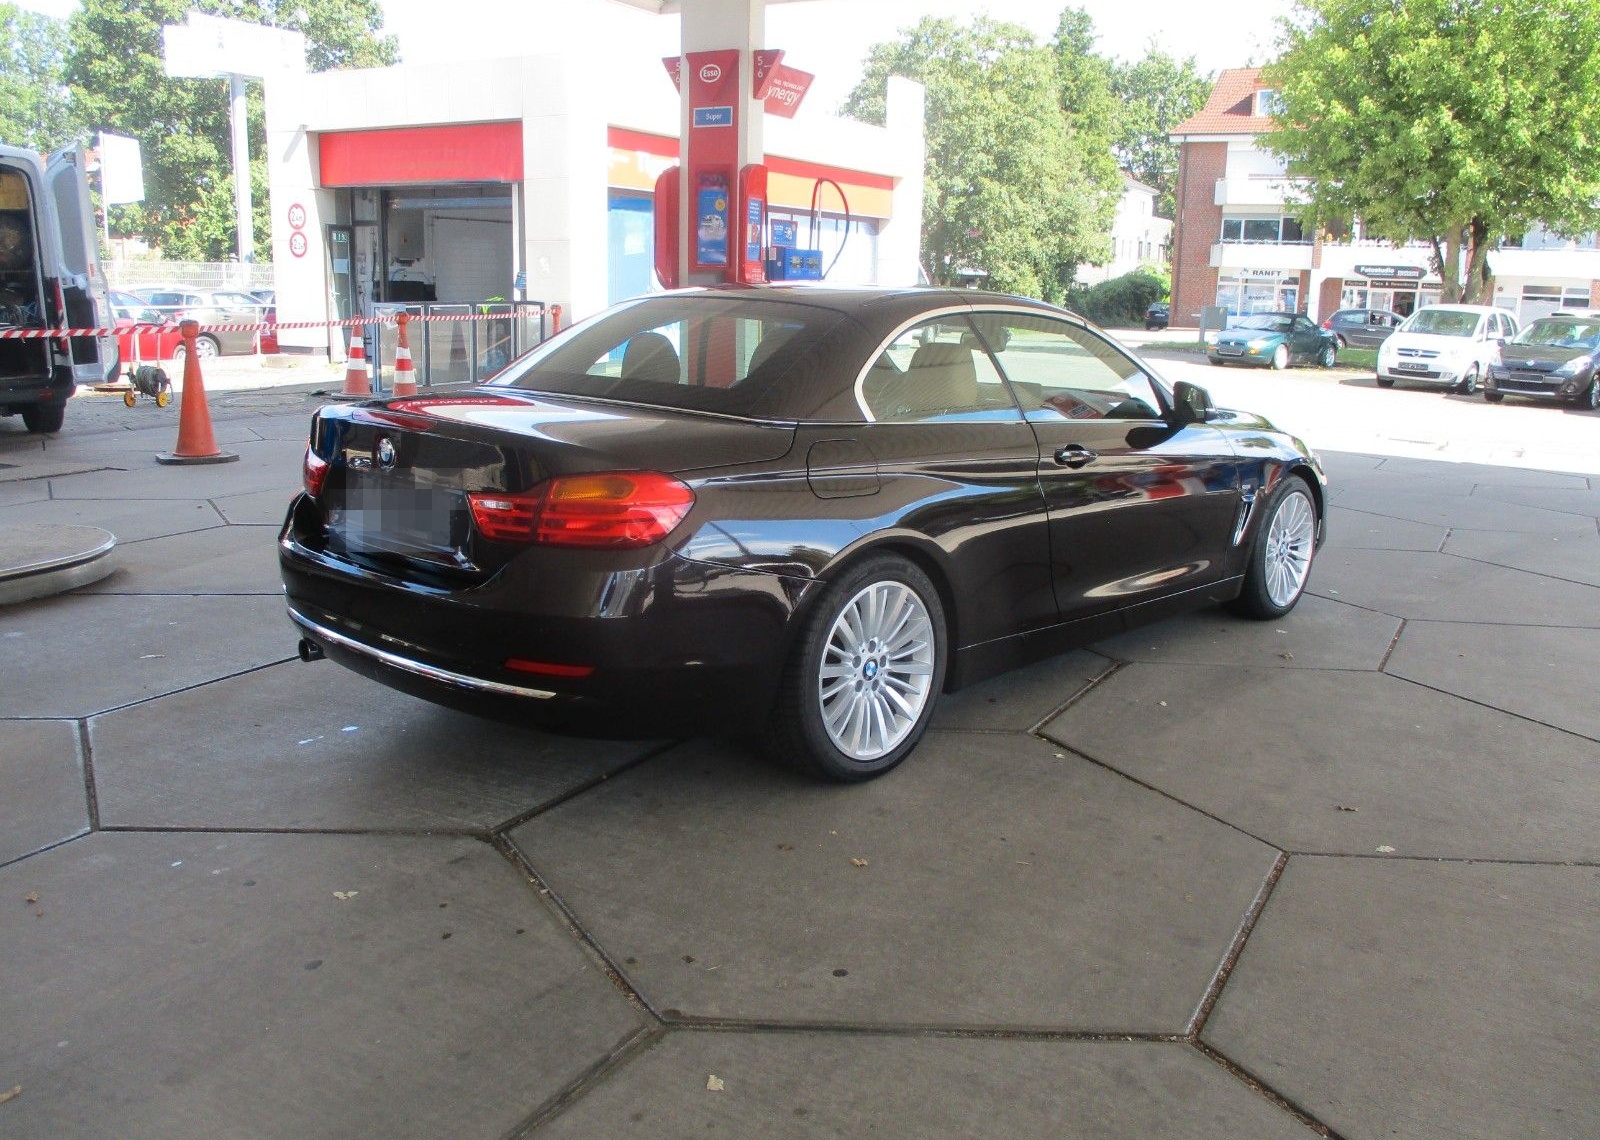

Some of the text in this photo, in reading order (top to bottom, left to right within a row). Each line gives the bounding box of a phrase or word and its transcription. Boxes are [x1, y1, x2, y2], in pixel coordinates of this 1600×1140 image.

[757, 56, 763, 66] 5
[702, 69, 719, 78] Esso
[757, 69, 763, 78] 6
[705, 113, 722, 121] Super
